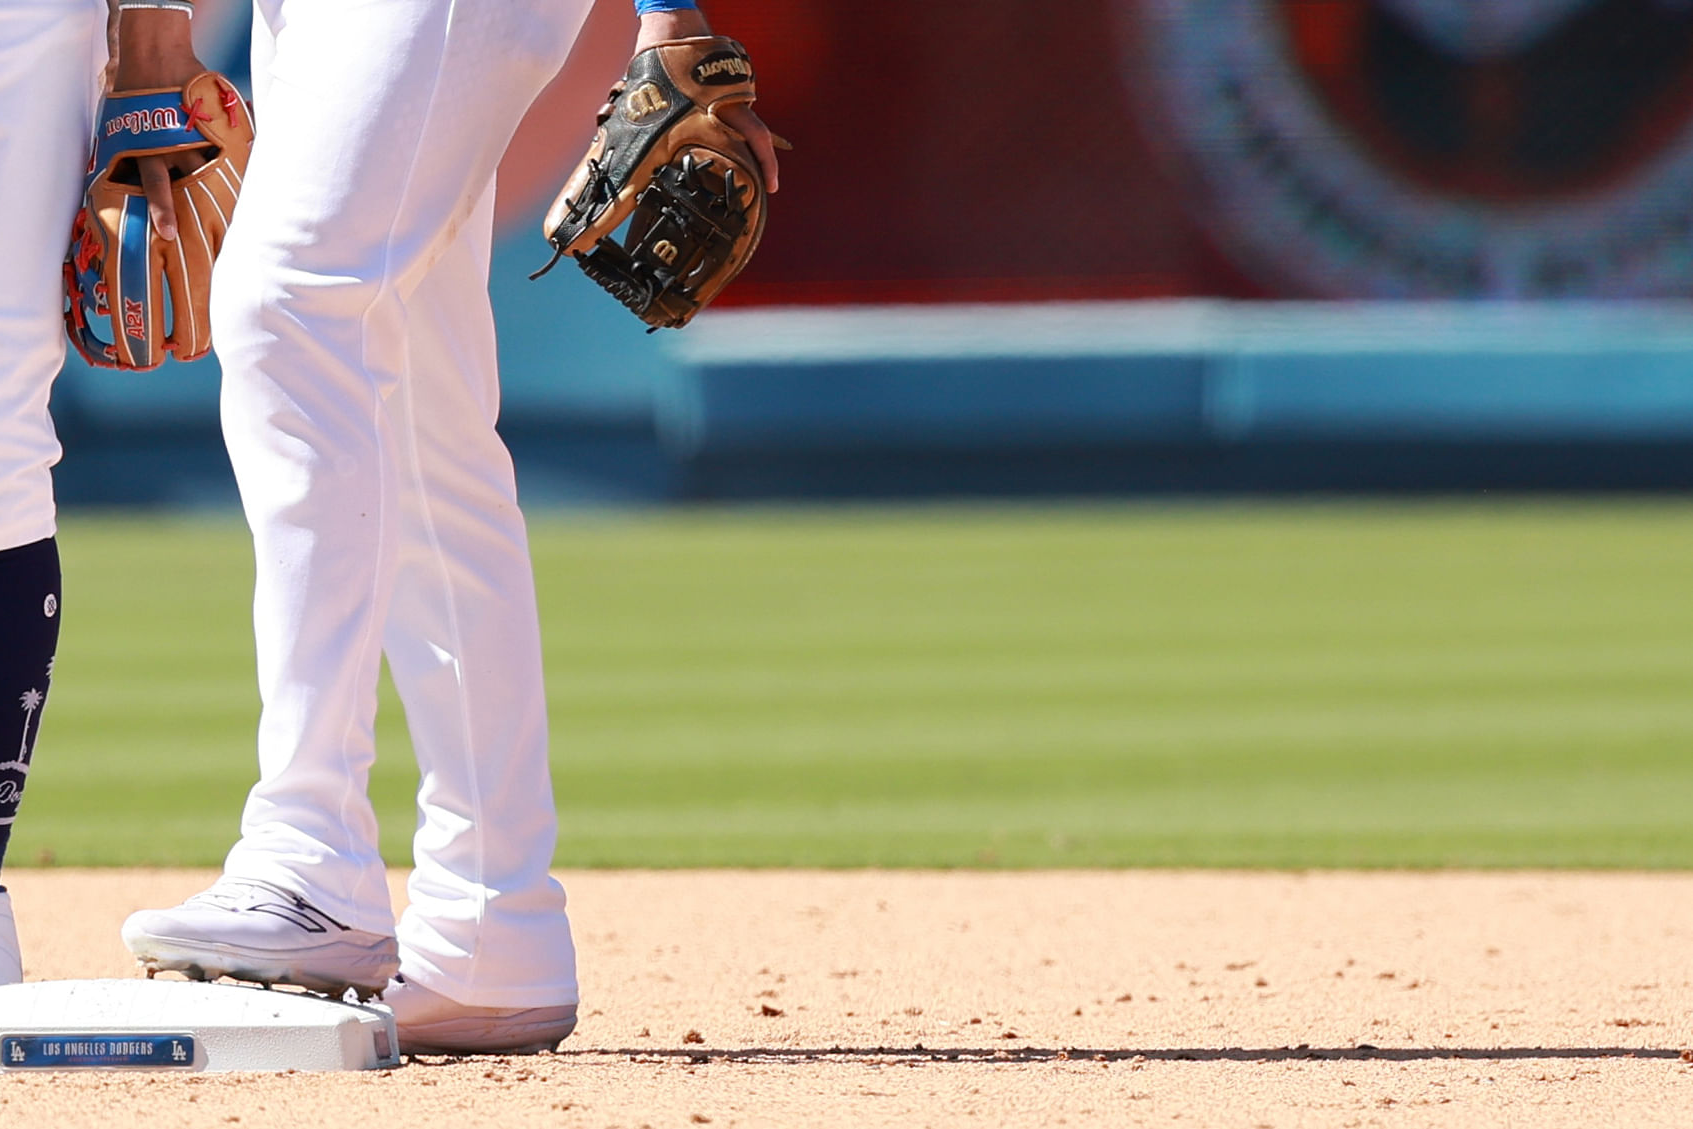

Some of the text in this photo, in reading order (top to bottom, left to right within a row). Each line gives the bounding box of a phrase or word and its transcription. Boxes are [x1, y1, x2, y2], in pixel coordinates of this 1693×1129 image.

[106, 107, 181, 136] Wilson
[124, 296, 145, 341] A2K
[11, 1041, 25, 1061] LA
[43, 1042, 153, 1056] LOS ANGELES DODGERS
[171, 1040, 186, 1061] LA
